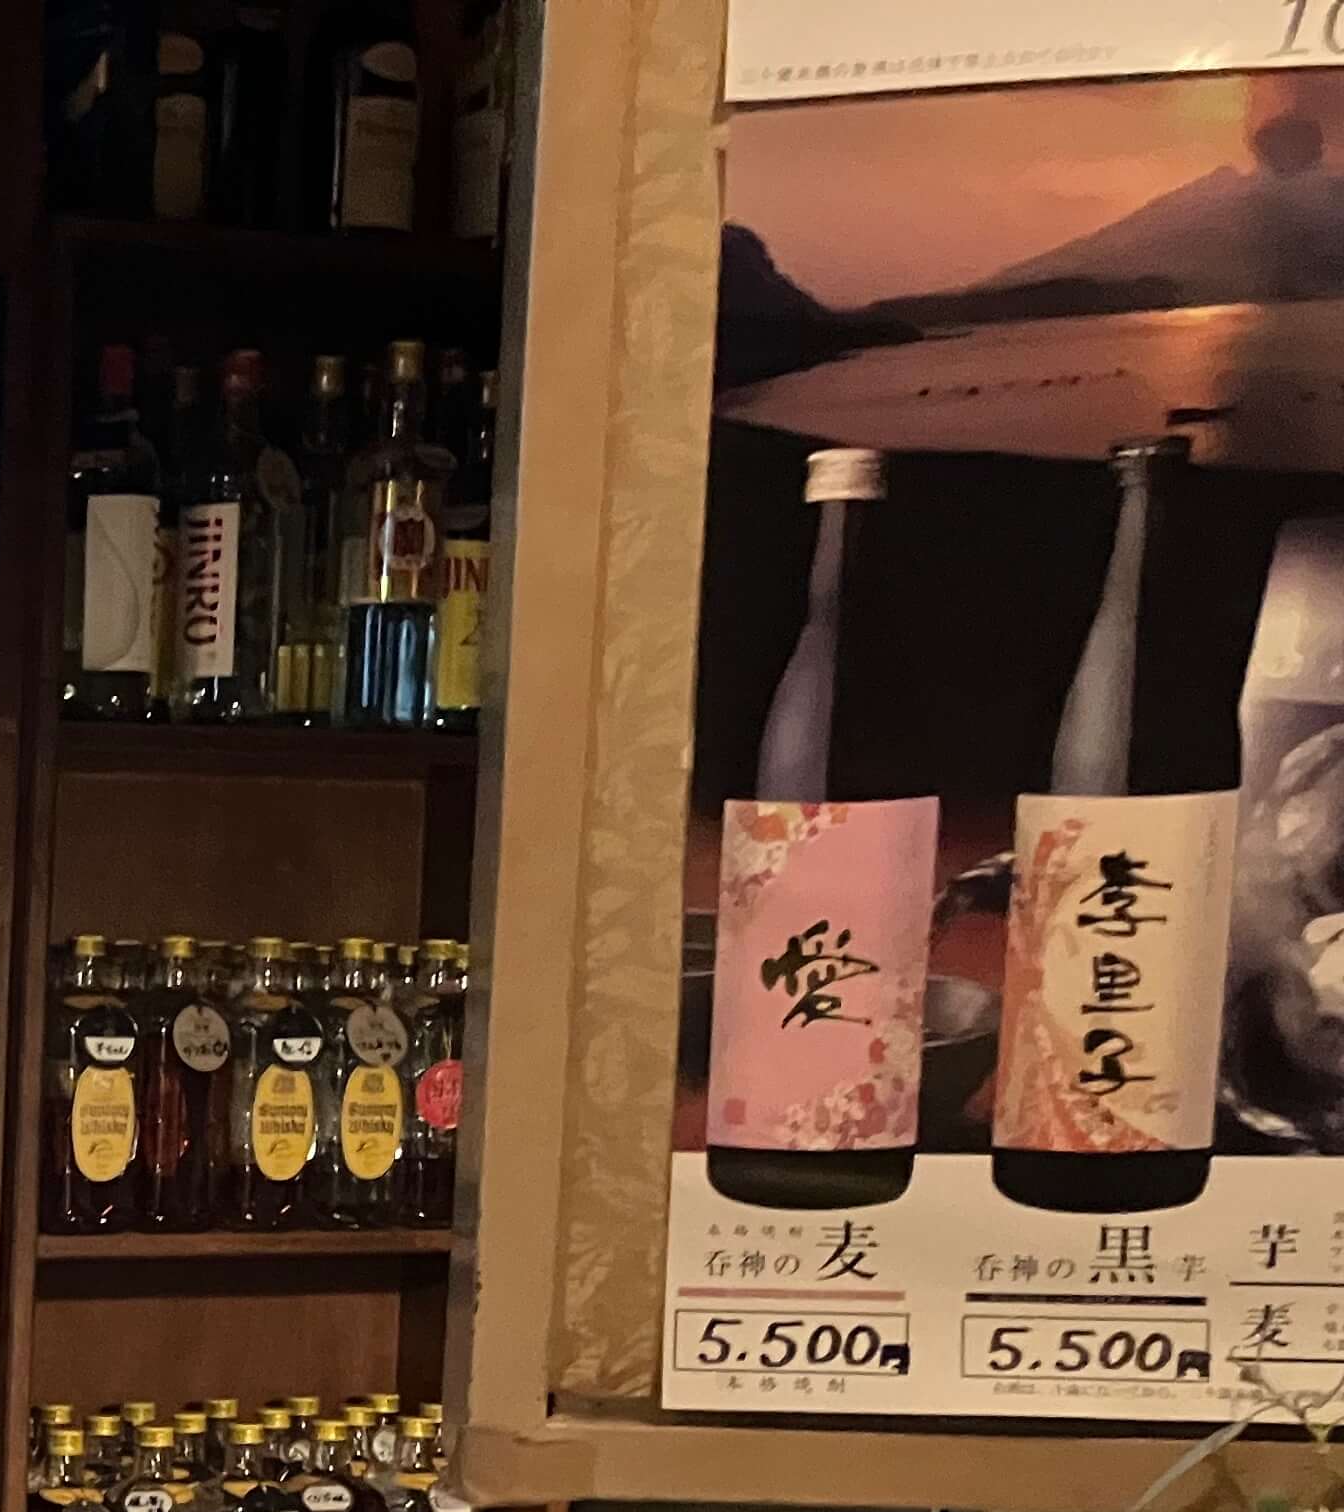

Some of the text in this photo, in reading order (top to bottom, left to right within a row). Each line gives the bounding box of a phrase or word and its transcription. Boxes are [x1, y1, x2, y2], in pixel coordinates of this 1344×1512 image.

[184, 517, 222, 645] JINRO
[760, 919, 880, 1029] 愛
[814, 1219, 880, 1282] 麦
[1087, 1223, 1158, 1286] 黒
[1248, 1223, 1300, 1271] 芋
[1241, 1304, 1292, 1350] 麦
